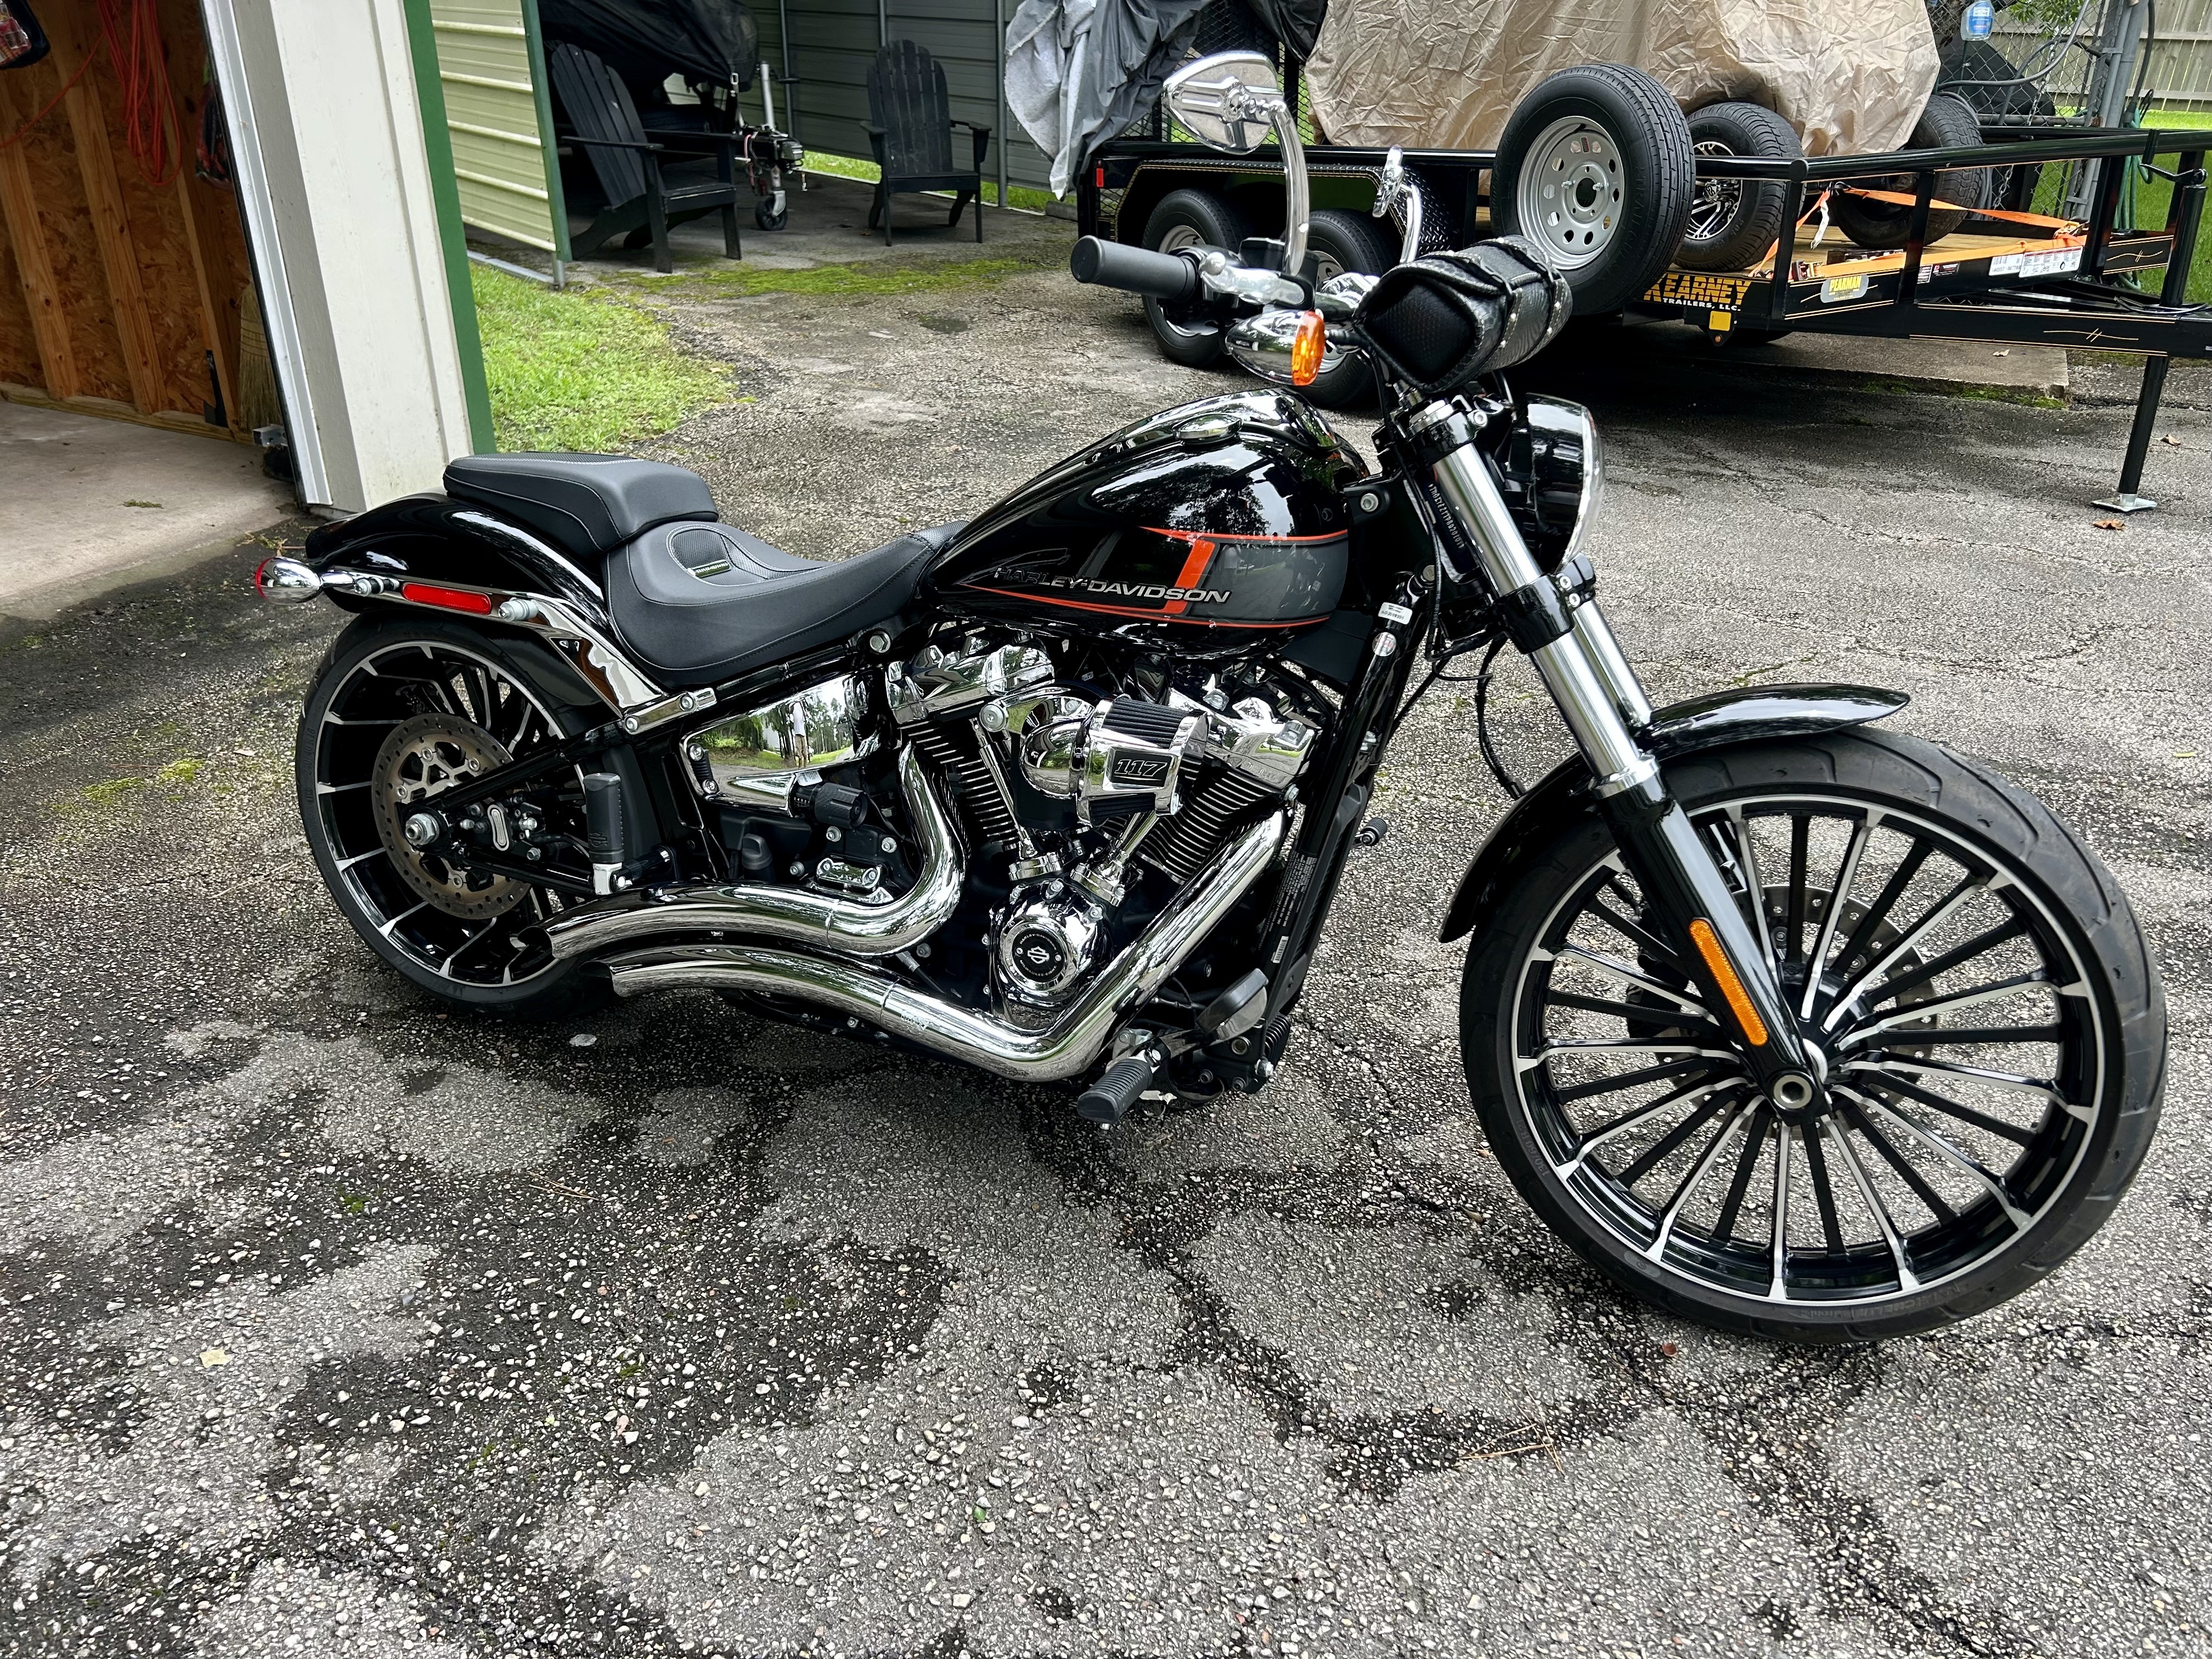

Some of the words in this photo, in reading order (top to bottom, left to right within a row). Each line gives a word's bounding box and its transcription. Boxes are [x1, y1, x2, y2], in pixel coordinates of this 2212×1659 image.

[1829, 275, 1862, 292] PEARMAN
[1663, 297, 1715, 309] TRAILERS,
[994, 567, 1232, 603] HARLEY-DAVIDSON
[1114, 759, 1168, 777] 117
